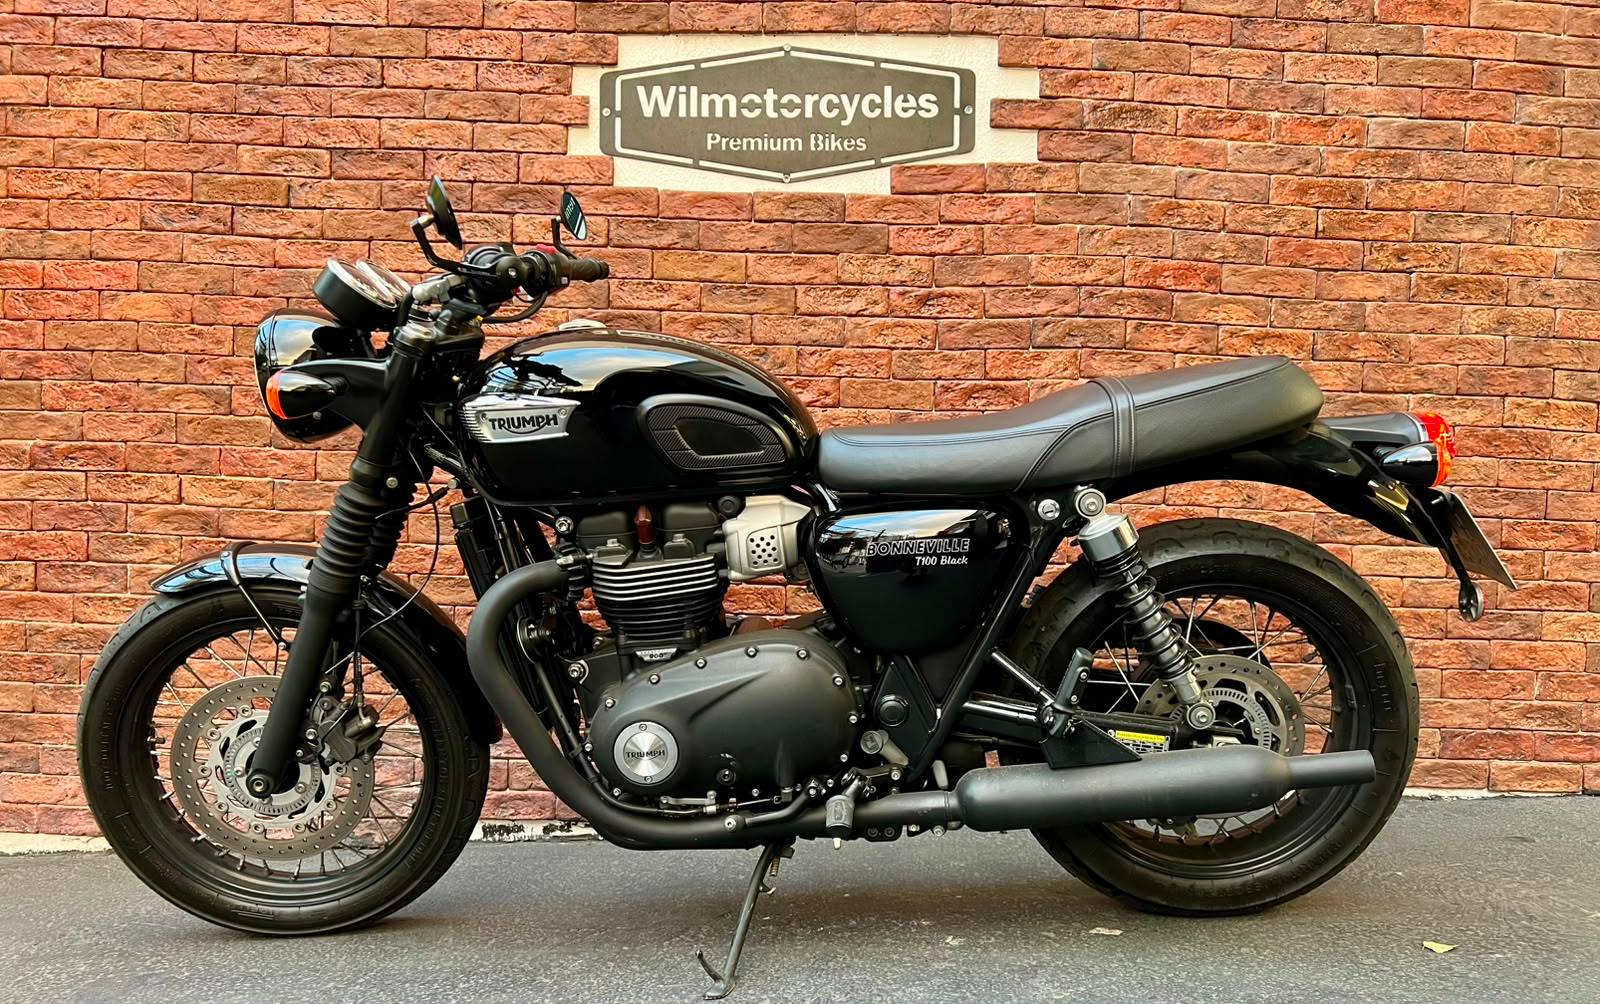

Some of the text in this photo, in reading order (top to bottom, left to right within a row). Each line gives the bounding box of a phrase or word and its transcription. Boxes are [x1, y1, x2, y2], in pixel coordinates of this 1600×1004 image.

[636, 85, 940, 126] Wilmotorcycles
[706, 132, 868, 152] Premium Bikes
[488, 414, 559, 434] TRIUMPH
[866, 538, 970, 556] BONNEVILLE
[915, 556, 968, 566] T100 Black
[626, 749, 666, 760] TRIUMPH
